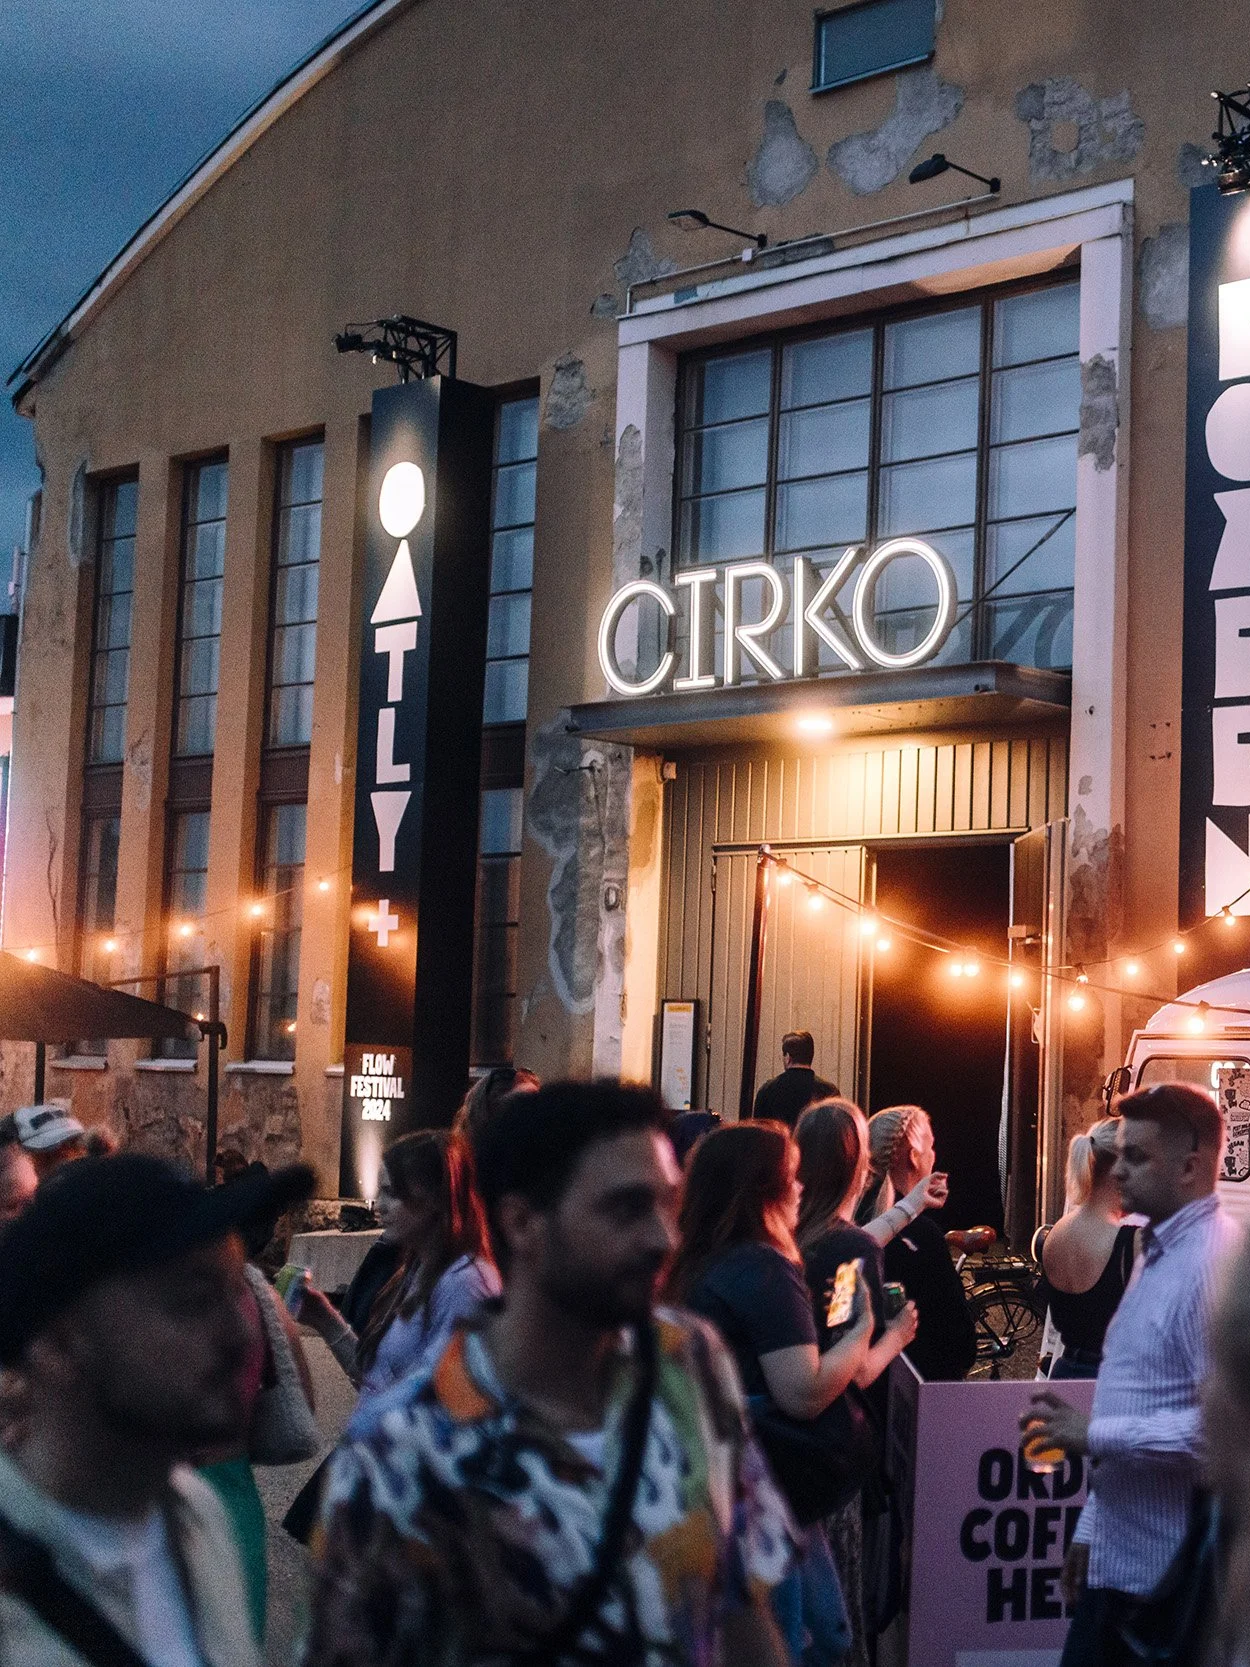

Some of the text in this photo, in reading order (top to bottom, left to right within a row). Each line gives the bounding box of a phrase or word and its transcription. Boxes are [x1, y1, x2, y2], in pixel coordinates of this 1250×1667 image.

[598, 538, 955, 696] CIRKO
[370, 461, 425, 872] OATLY
[350, 1075, 404, 1098] FESTIVAL
[362, 1053, 395, 1075] FLOW
[362, 1098, 391, 1121] 2024
[977, 1448, 1092, 1502] ORD
[987, 1567, 1073, 1624] HE
